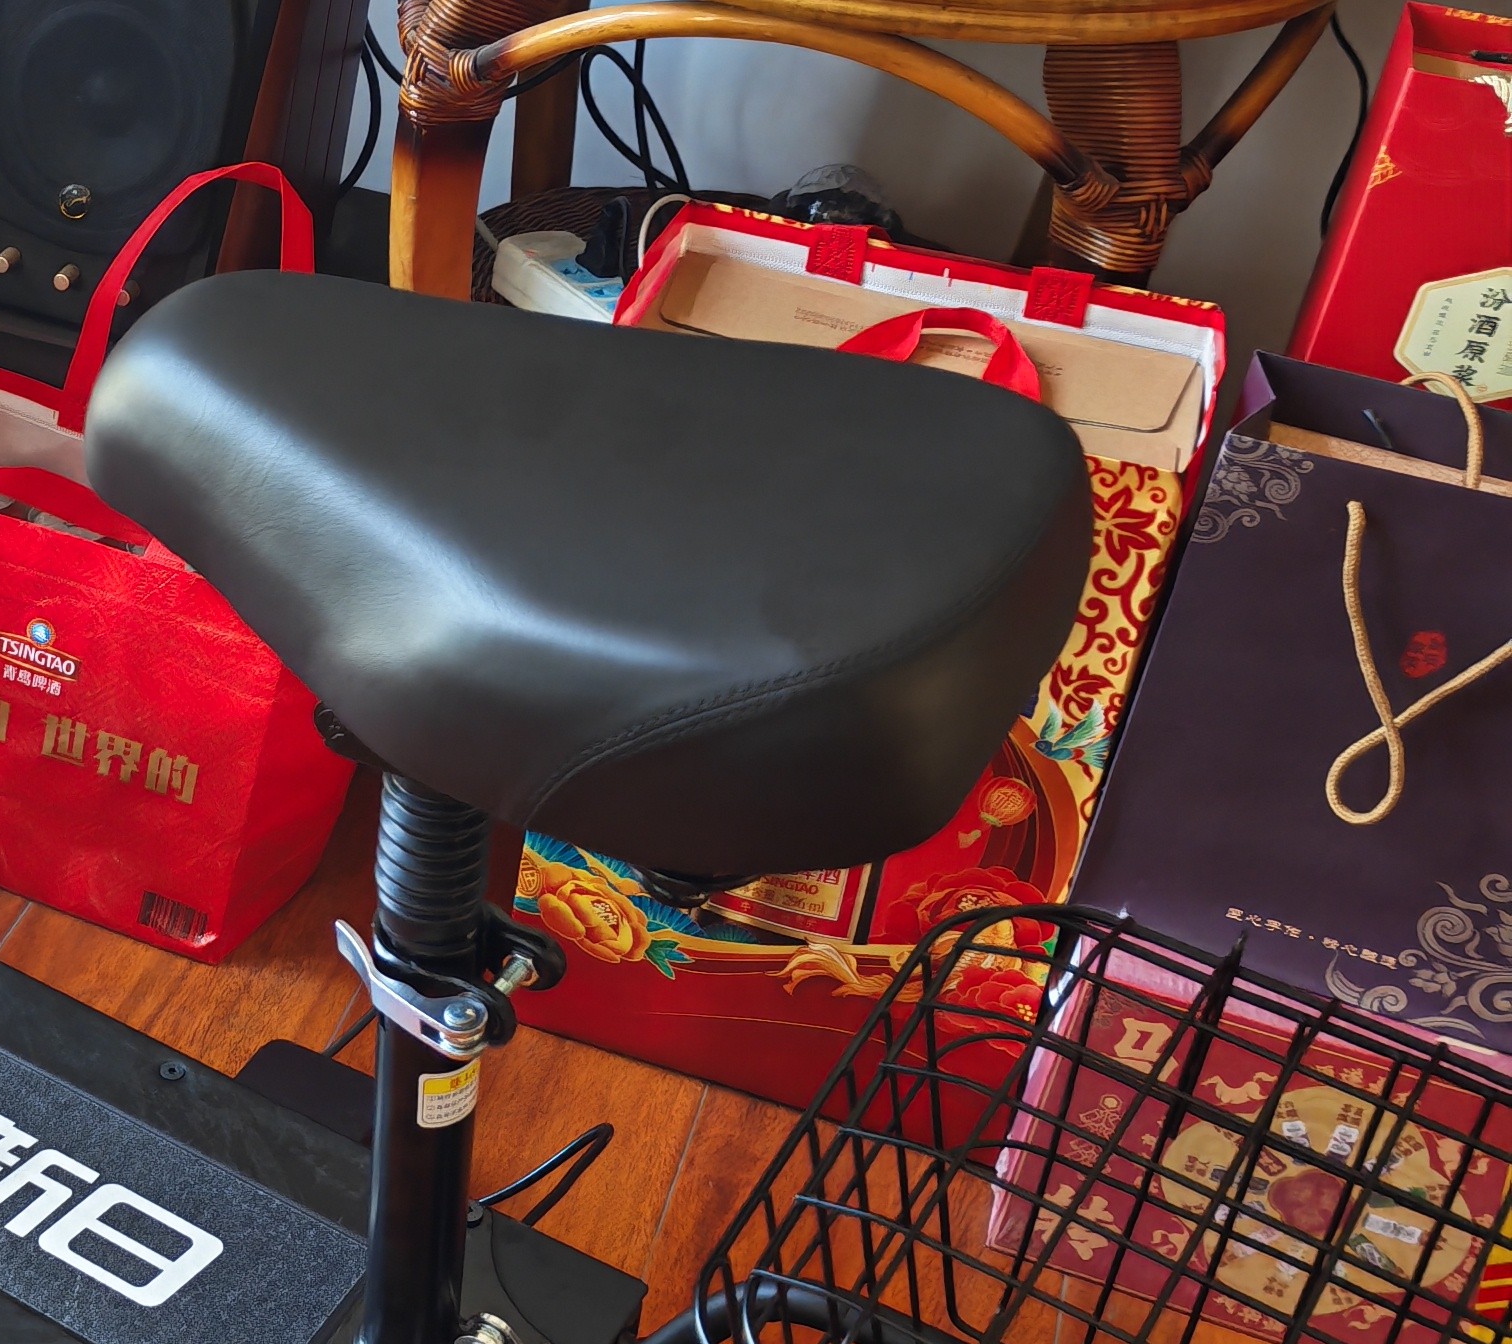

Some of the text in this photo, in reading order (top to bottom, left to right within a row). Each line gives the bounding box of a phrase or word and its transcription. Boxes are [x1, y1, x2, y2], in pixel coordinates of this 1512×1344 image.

[0, 636, 76, 676] TSINGTAO
[3, 662, 62, 697] 青岛啤酒
[40, 713, 200, 805] 世界的
